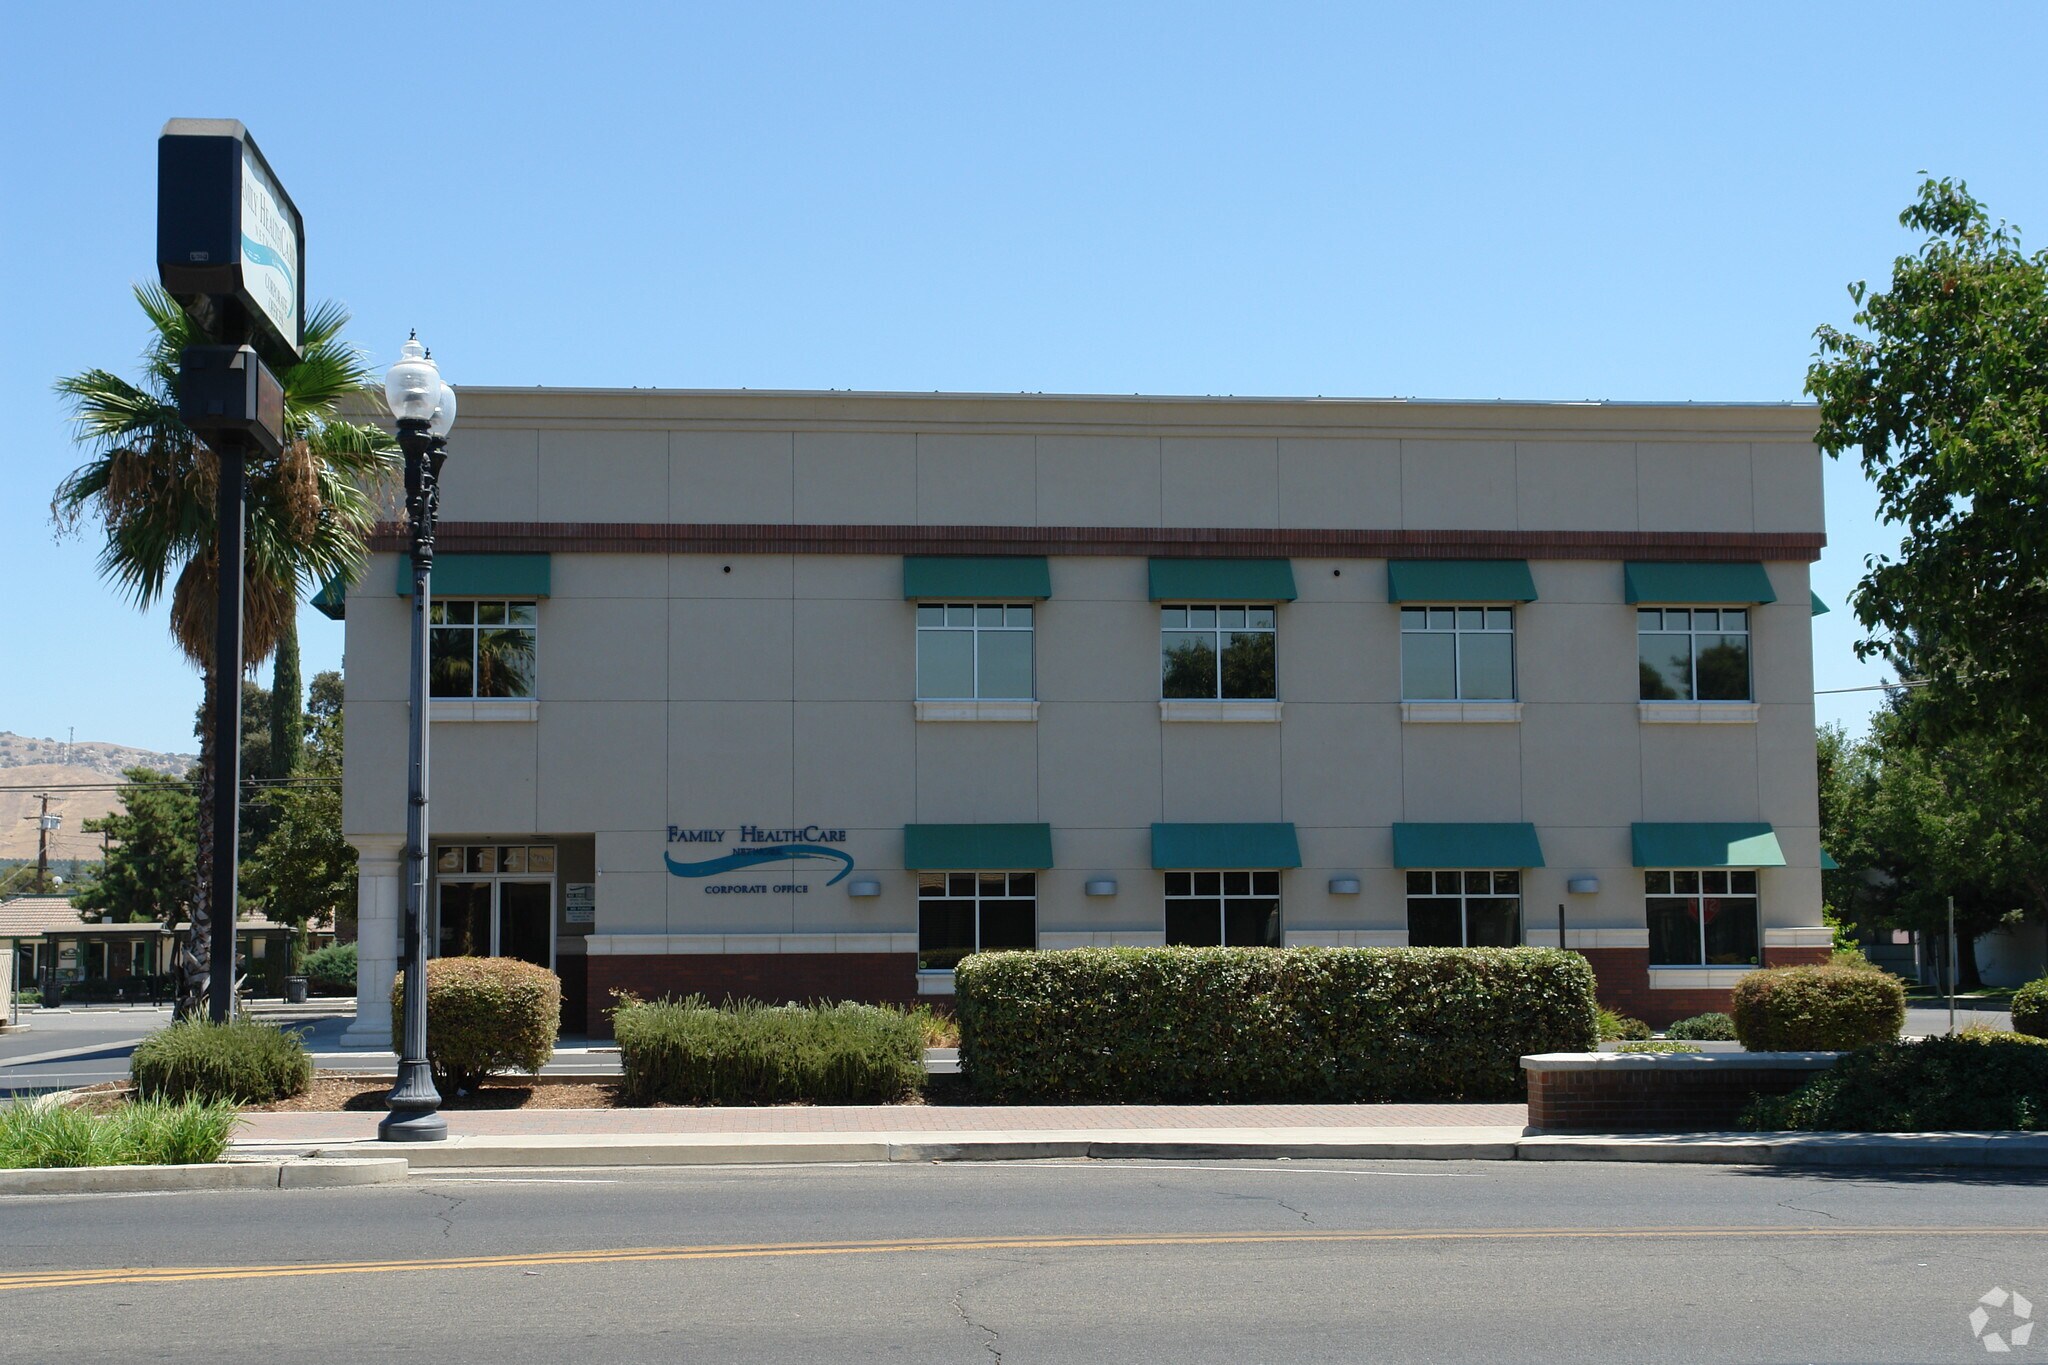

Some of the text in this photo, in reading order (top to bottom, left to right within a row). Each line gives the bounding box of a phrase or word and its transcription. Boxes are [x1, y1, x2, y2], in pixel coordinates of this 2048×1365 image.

[264, 272, 288, 315] CORPORATE
[668, 825, 847, 842] FAMILY HEALTHCARE
[704, 884, 809, 894] CORPORATE OFFICE
